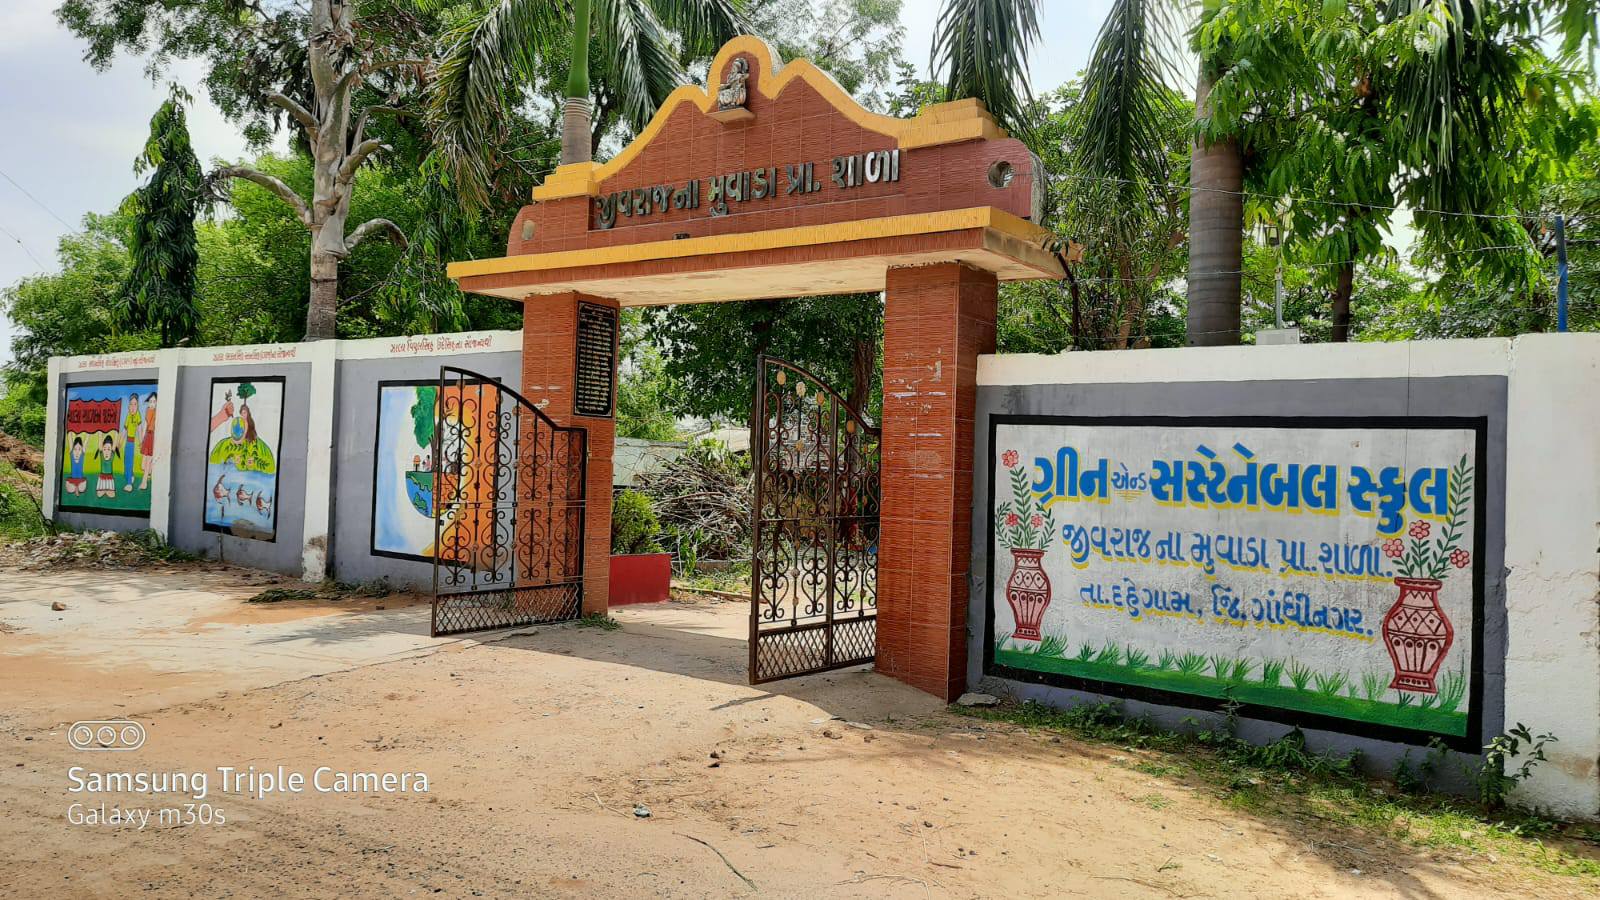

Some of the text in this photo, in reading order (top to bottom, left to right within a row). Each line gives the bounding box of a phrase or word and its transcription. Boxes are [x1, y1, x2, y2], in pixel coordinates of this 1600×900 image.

[708, 166, 776, 217] મુવાડા
[786, 161, 821, 195] પ્રા.
[832, 149, 899, 188] શાળા
[1031, 446, 1109, 504] ગ્રીન
[1149, 442, 1338, 511] સસ્ટેનેબલ
[1190, 533, 1271, 575] મુવાડા
